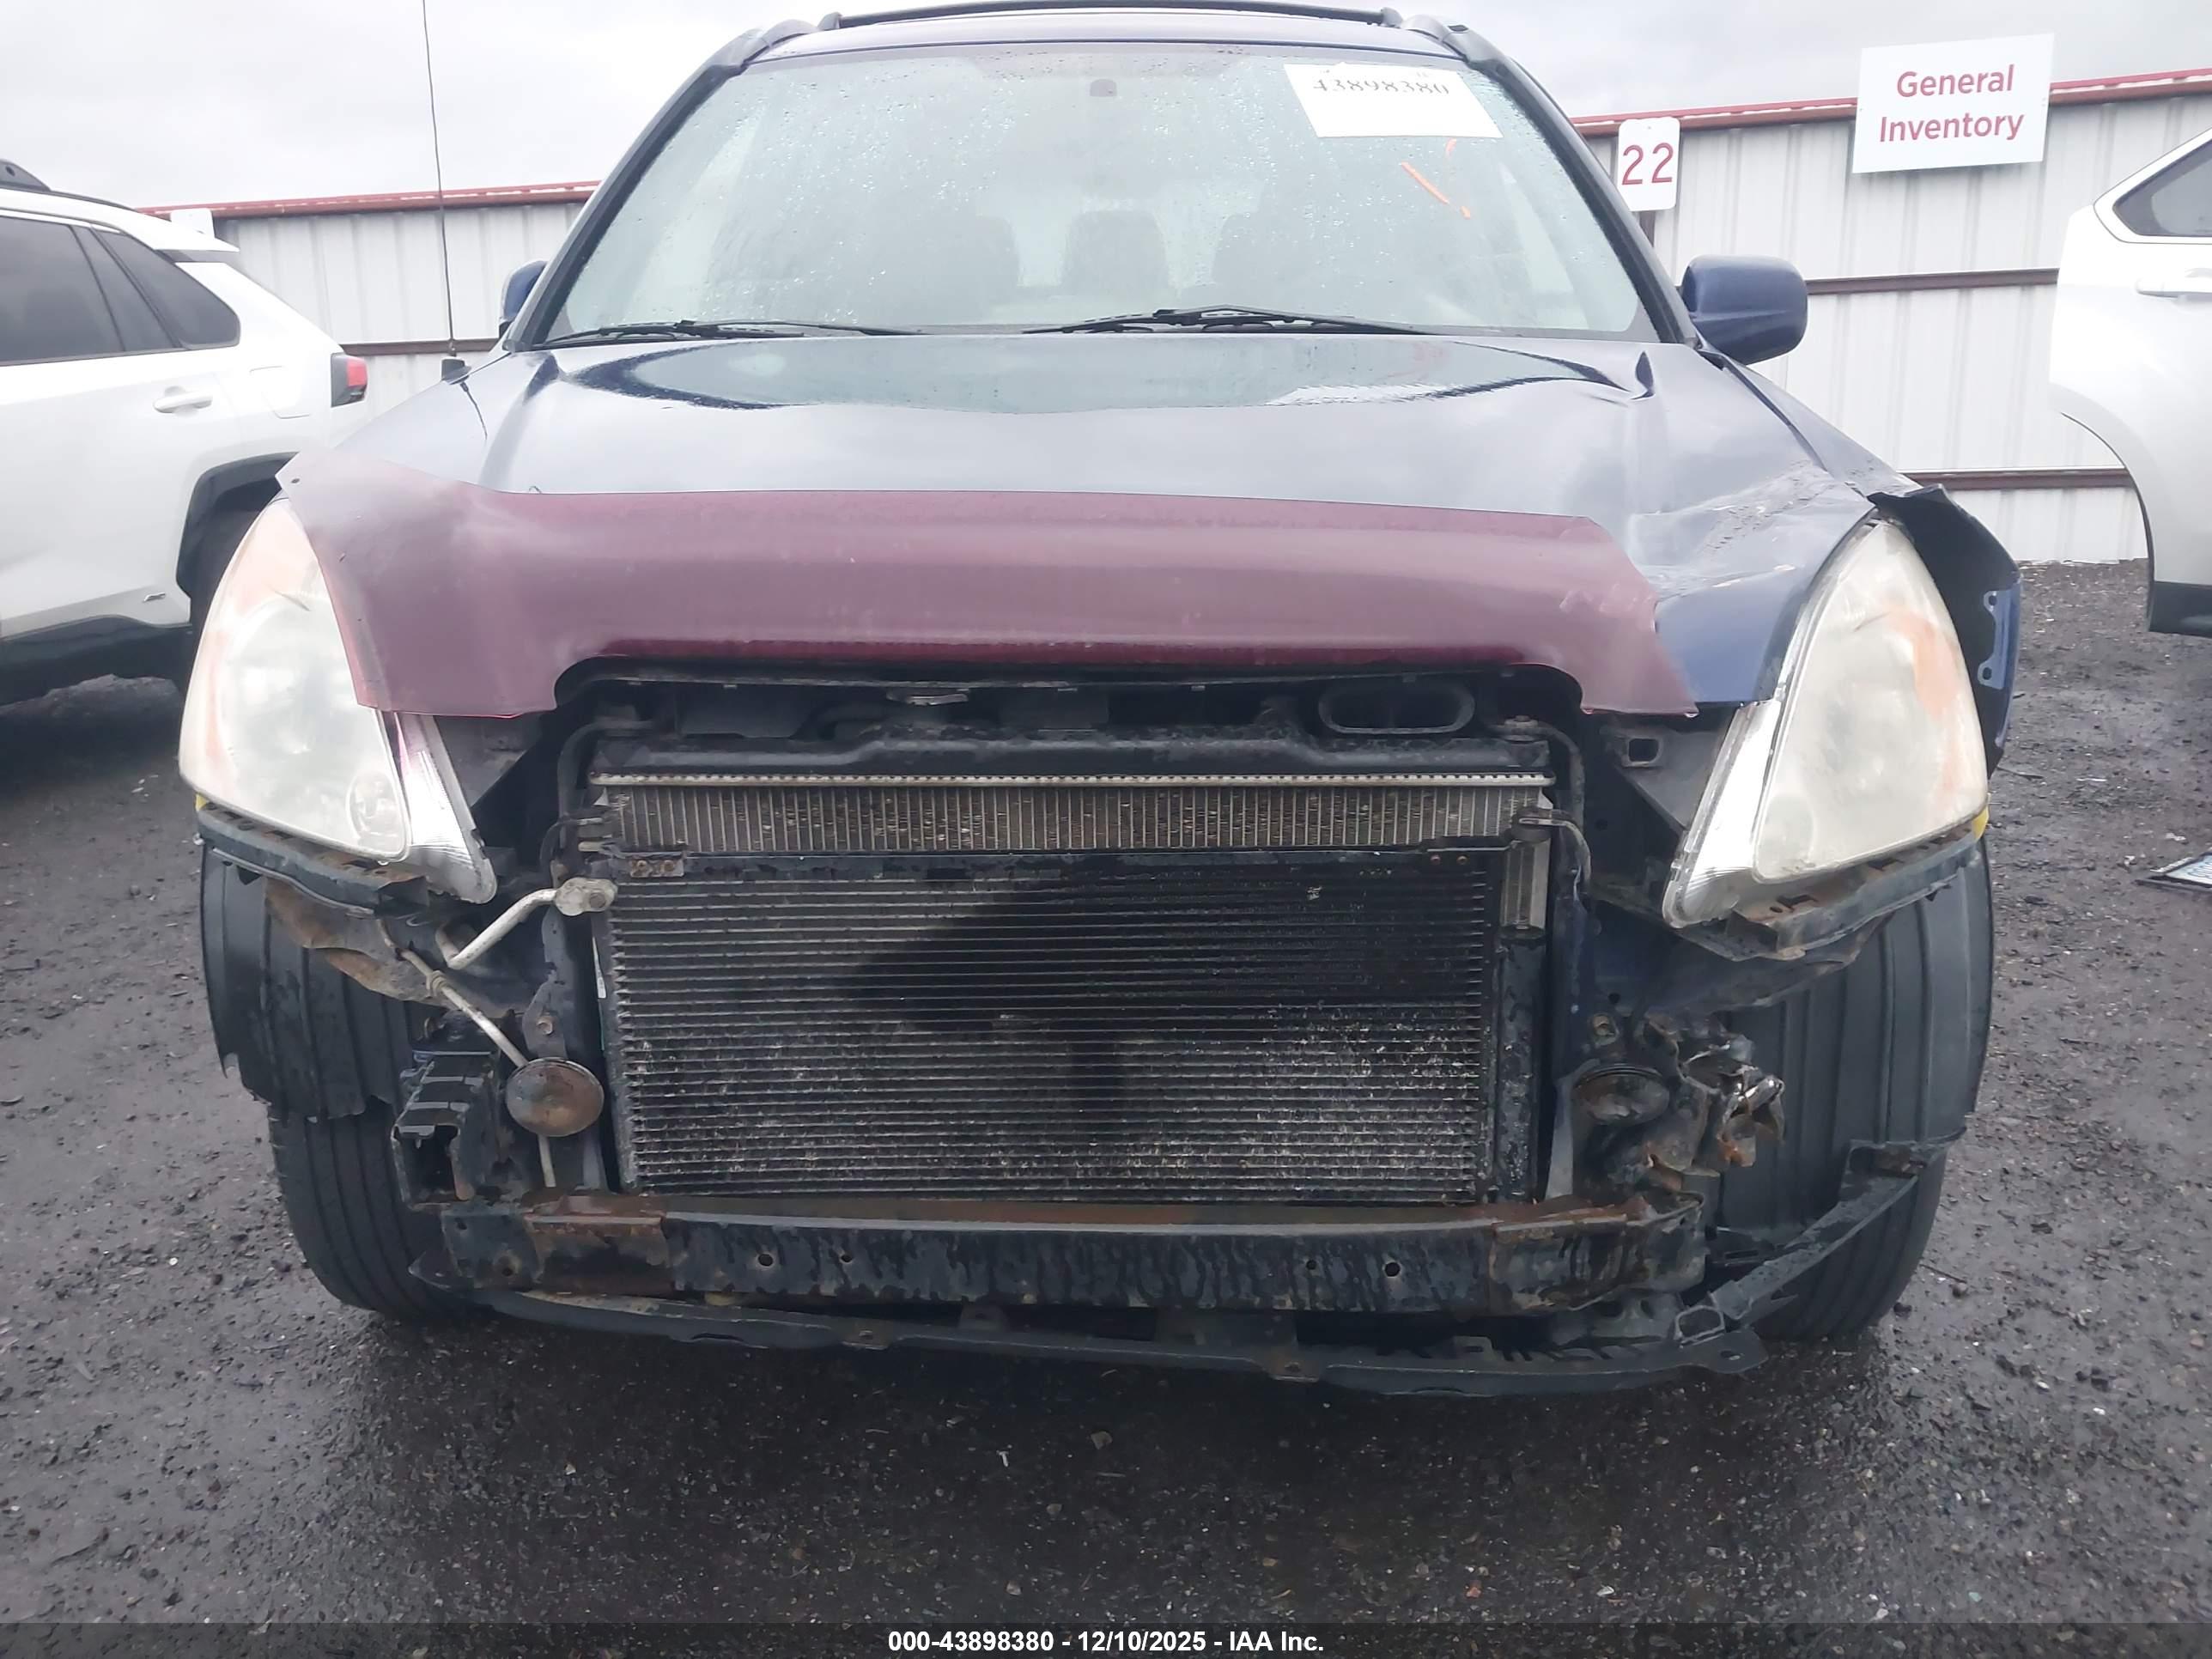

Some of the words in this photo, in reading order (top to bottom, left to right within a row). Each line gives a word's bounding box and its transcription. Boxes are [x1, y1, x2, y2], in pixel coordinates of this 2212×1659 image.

[1896, 64, 2015, 98] General
[1879, 112, 2026, 143] Inventory
[1620, 142, 1674, 186] 22
